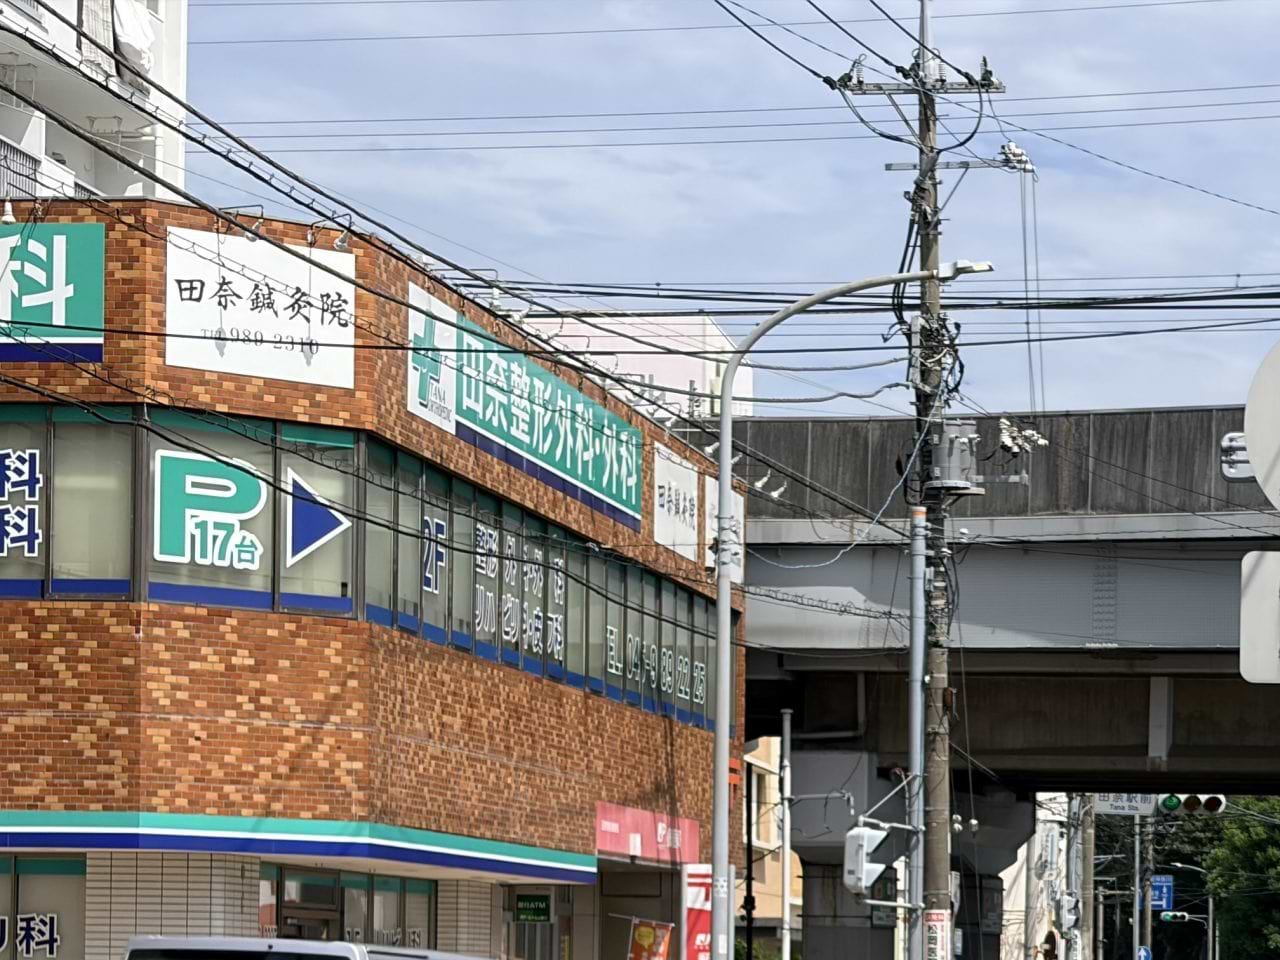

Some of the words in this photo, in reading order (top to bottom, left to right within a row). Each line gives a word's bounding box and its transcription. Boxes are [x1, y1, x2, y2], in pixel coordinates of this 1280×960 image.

[0, 234, 74, 326] 科
[174, 276, 349, 328] 田奈鍼灸院
[194, 519, 259, 565] 17台
[423, 516, 447, 595] 2F
